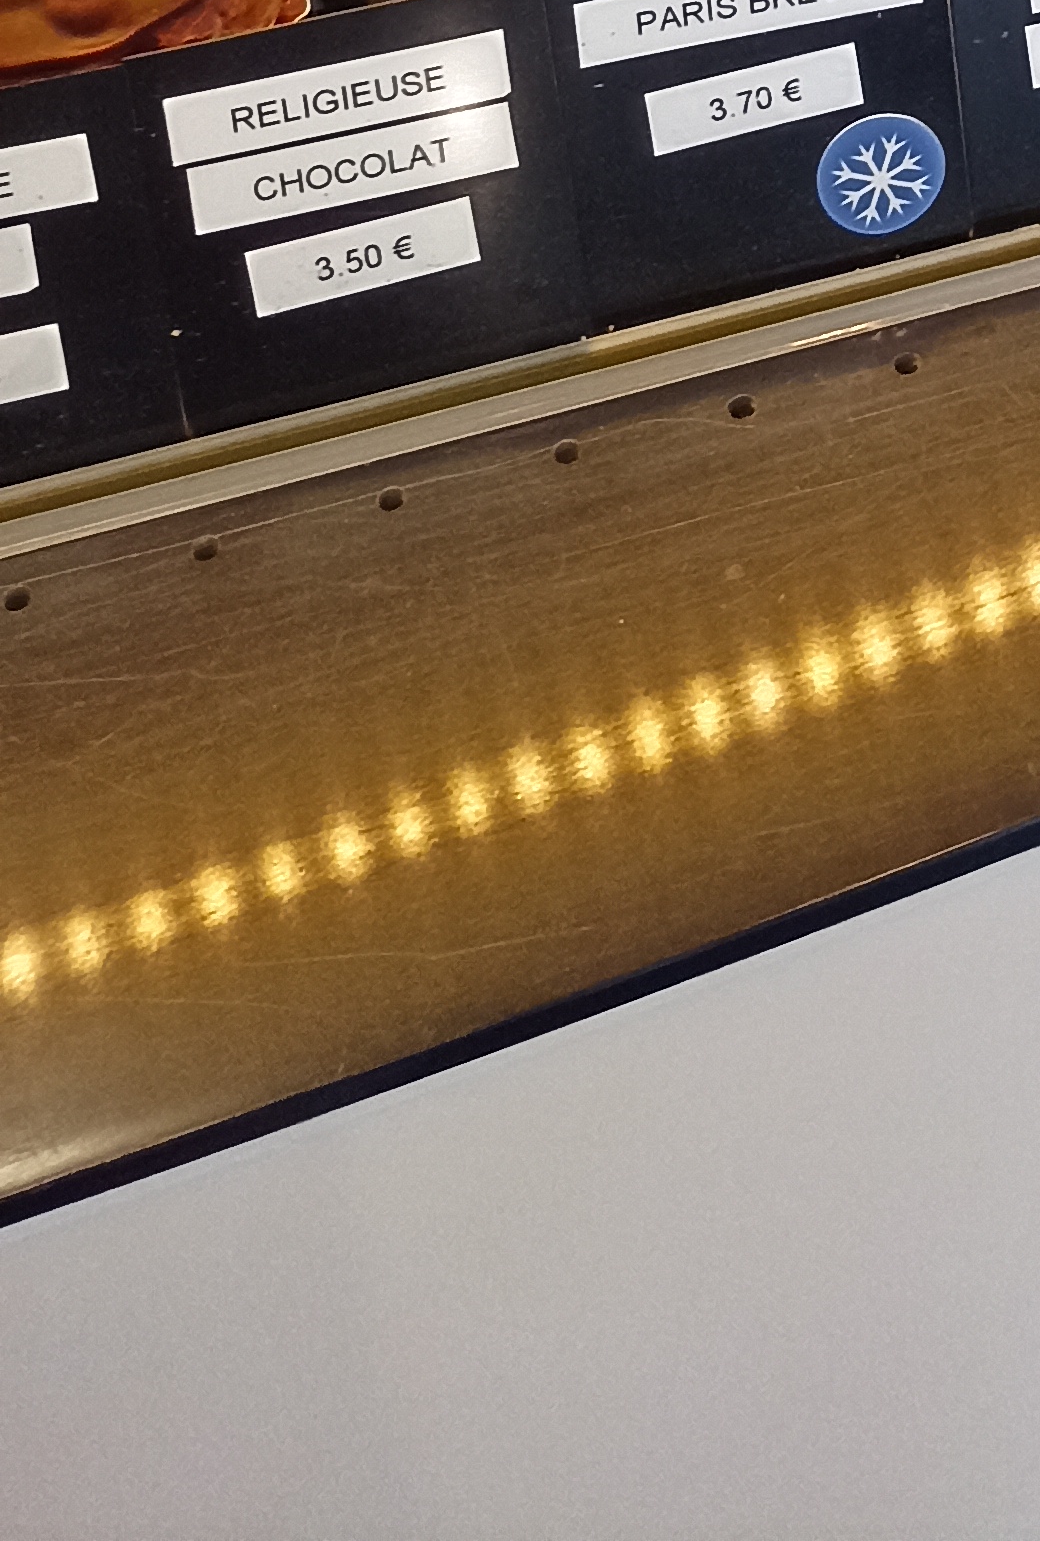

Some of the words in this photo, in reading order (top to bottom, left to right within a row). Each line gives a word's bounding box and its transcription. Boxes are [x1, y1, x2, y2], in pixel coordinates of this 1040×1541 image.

[231, 65, 445, 133] RELIGIEUSE
[709, 87, 773, 122] 3.70
[782, 77, 802, 102] €
[253, 138, 450, 202] CHOCOLAT
[315, 243, 383, 282] 3.50
[392, 235, 415, 260] €
